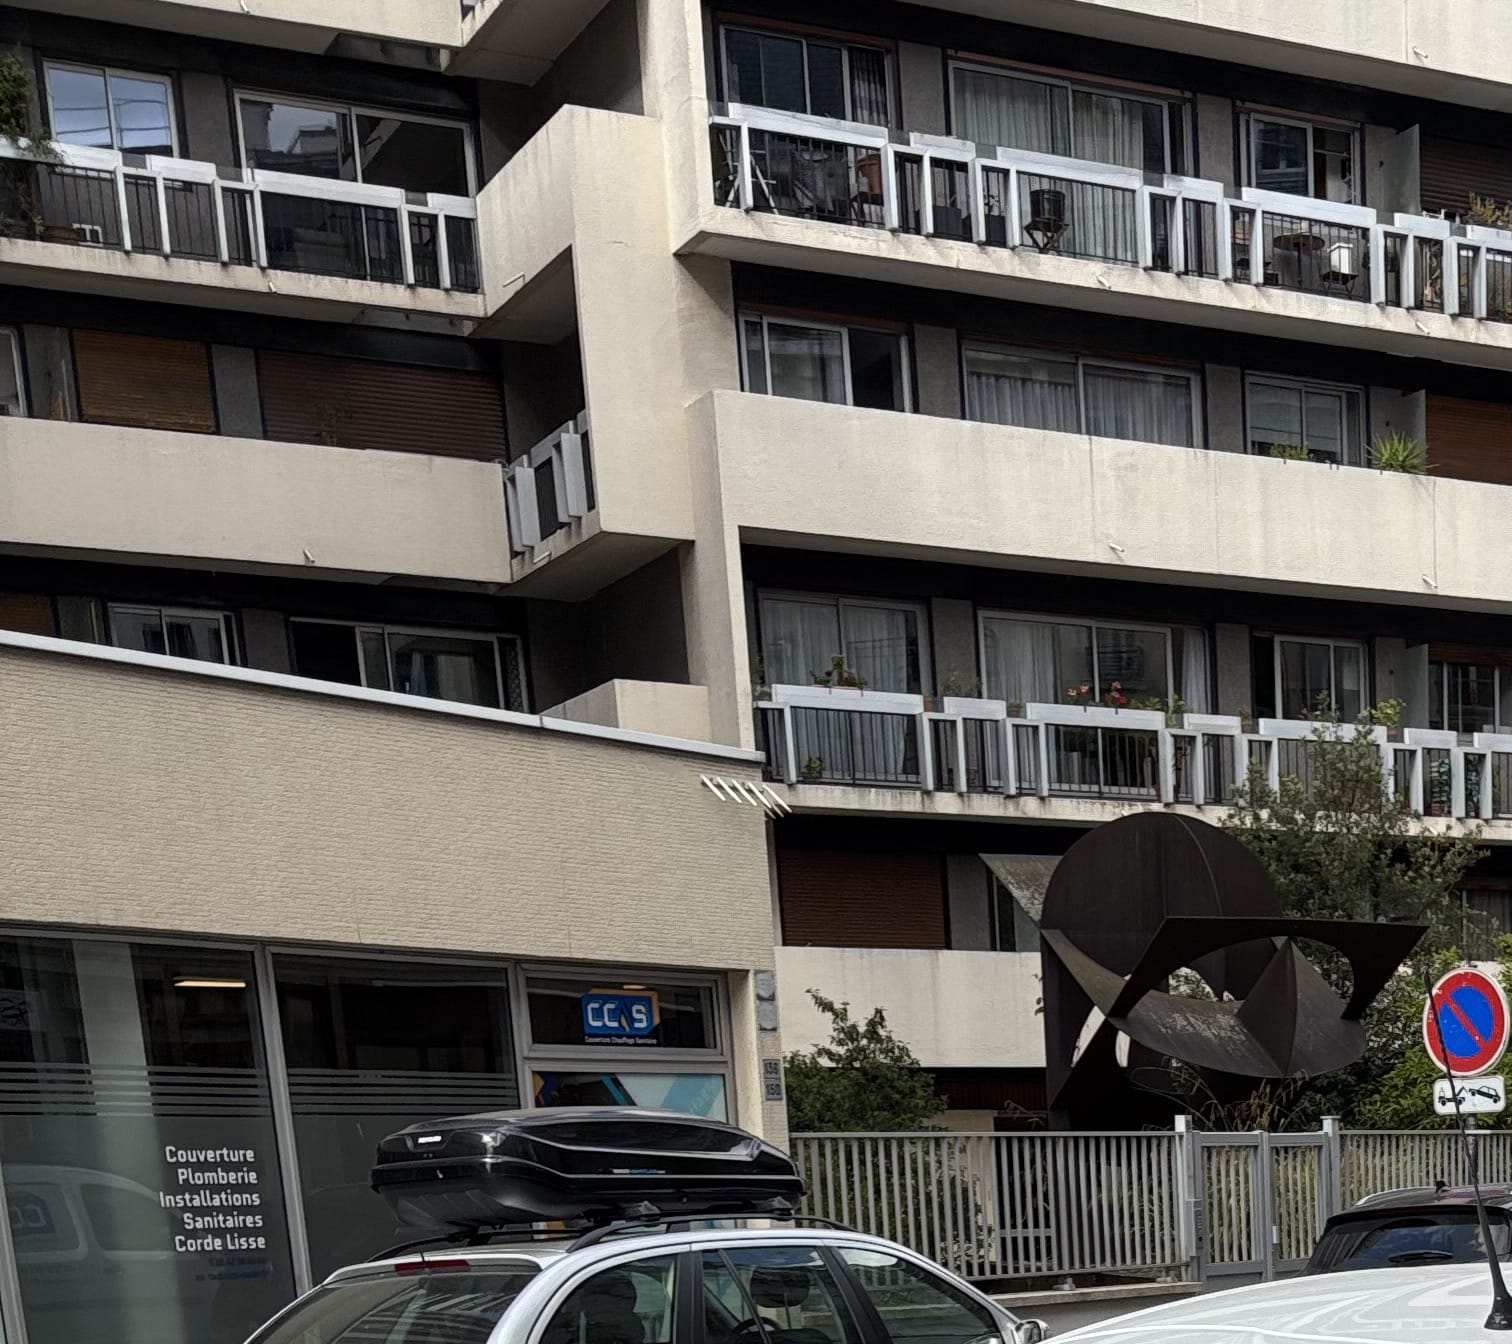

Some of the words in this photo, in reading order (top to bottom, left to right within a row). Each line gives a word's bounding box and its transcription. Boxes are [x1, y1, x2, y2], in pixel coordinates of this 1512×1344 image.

[165, 1145, 255, 1162] Couverture
[177, 1167, 258, 1184] Plomberie
[159, 1189, 261, 1207] Installations
[183, 1211, 263, 1229] Sanitaires
[175, 1234, 222, 1251] Corde
[226, 1233, 266, 1249] Lisse
